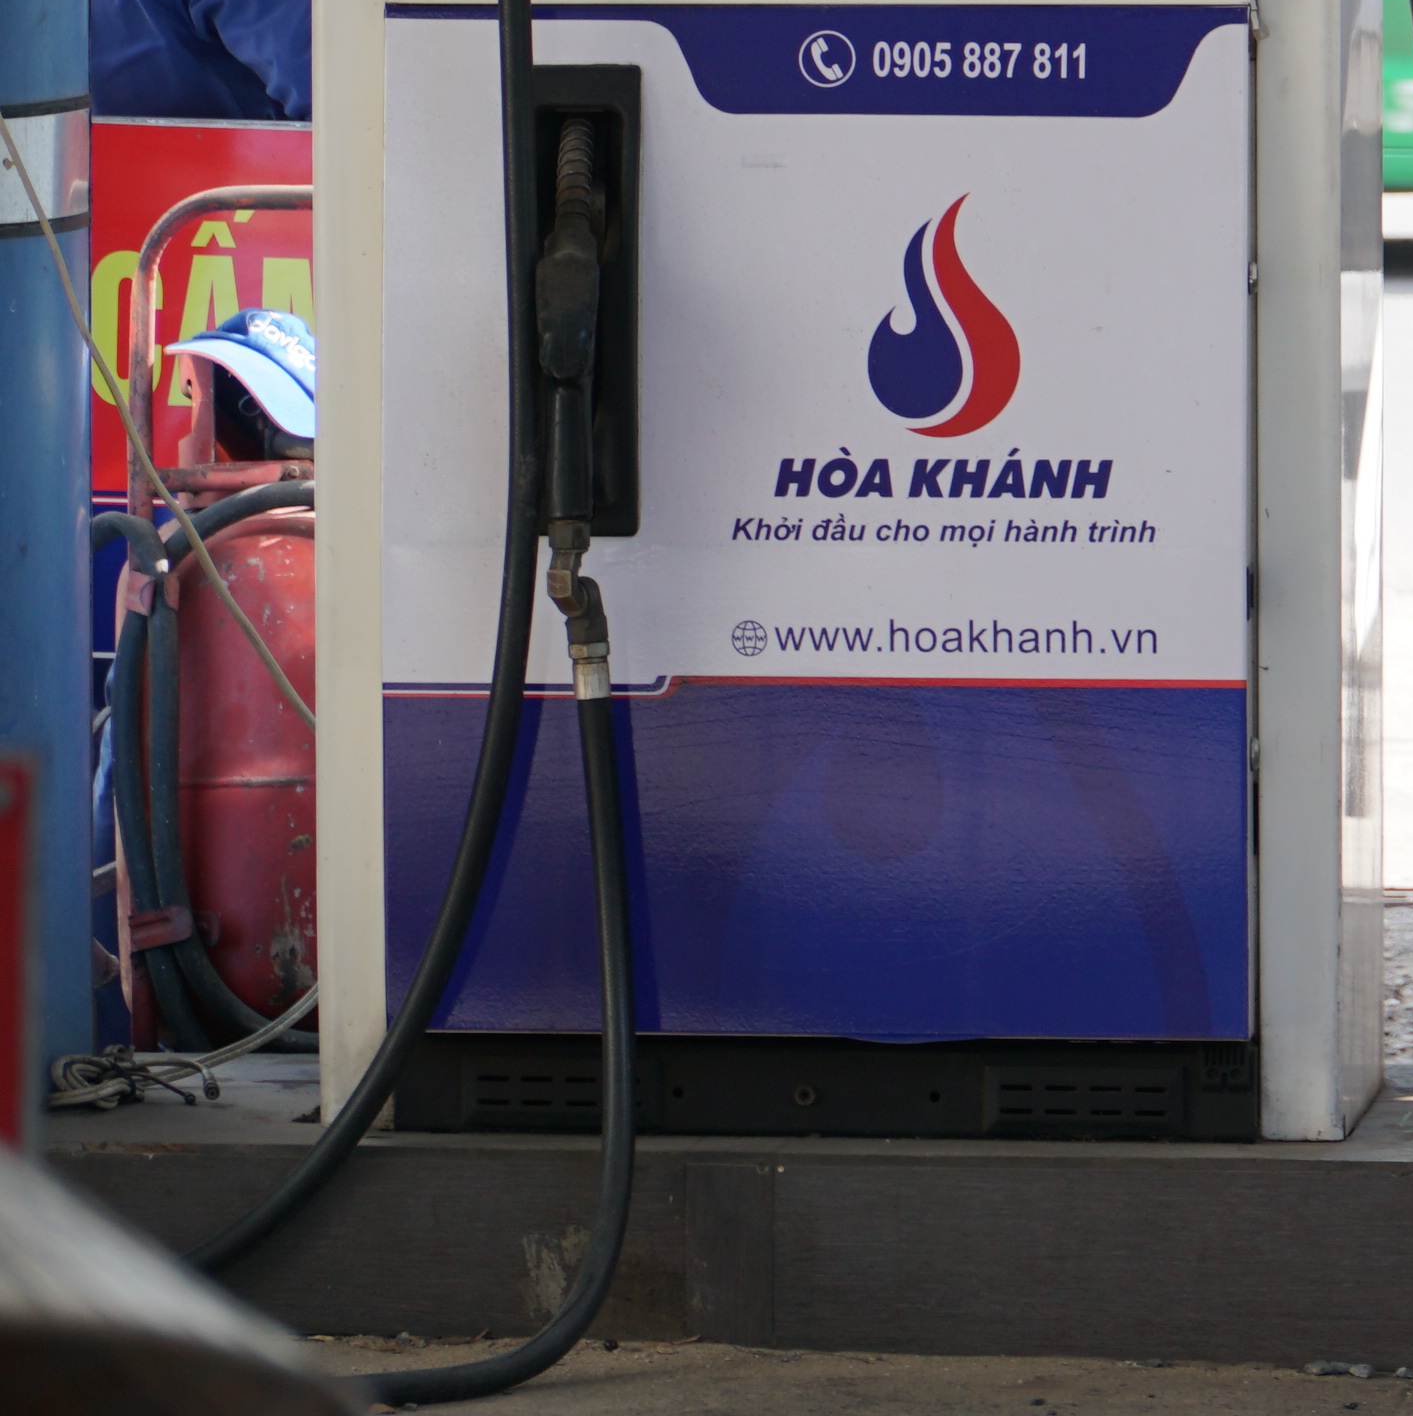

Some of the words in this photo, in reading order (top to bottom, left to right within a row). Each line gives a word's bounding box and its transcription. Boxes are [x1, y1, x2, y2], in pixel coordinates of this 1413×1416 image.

[872, 40, 952, 79] 0905
[962, 41, 1023, 79] 887
[1032, 42, 1087, 79] 811
[773, 446, 894, 499] HÒA
[907, 447, 1114, 500] KHÁNH
[731, 516, 803, 542] Khởi
[811, 512, 866, 543] đầu
[875, 518, 930, 543] cho
[939, 518, 996, 549] mọi
[1003, 518, 1078, 544] hành
[1087, 519, 1157, 544] trình
[773, 617, 1159, 655] www.hoakhanh.vn
